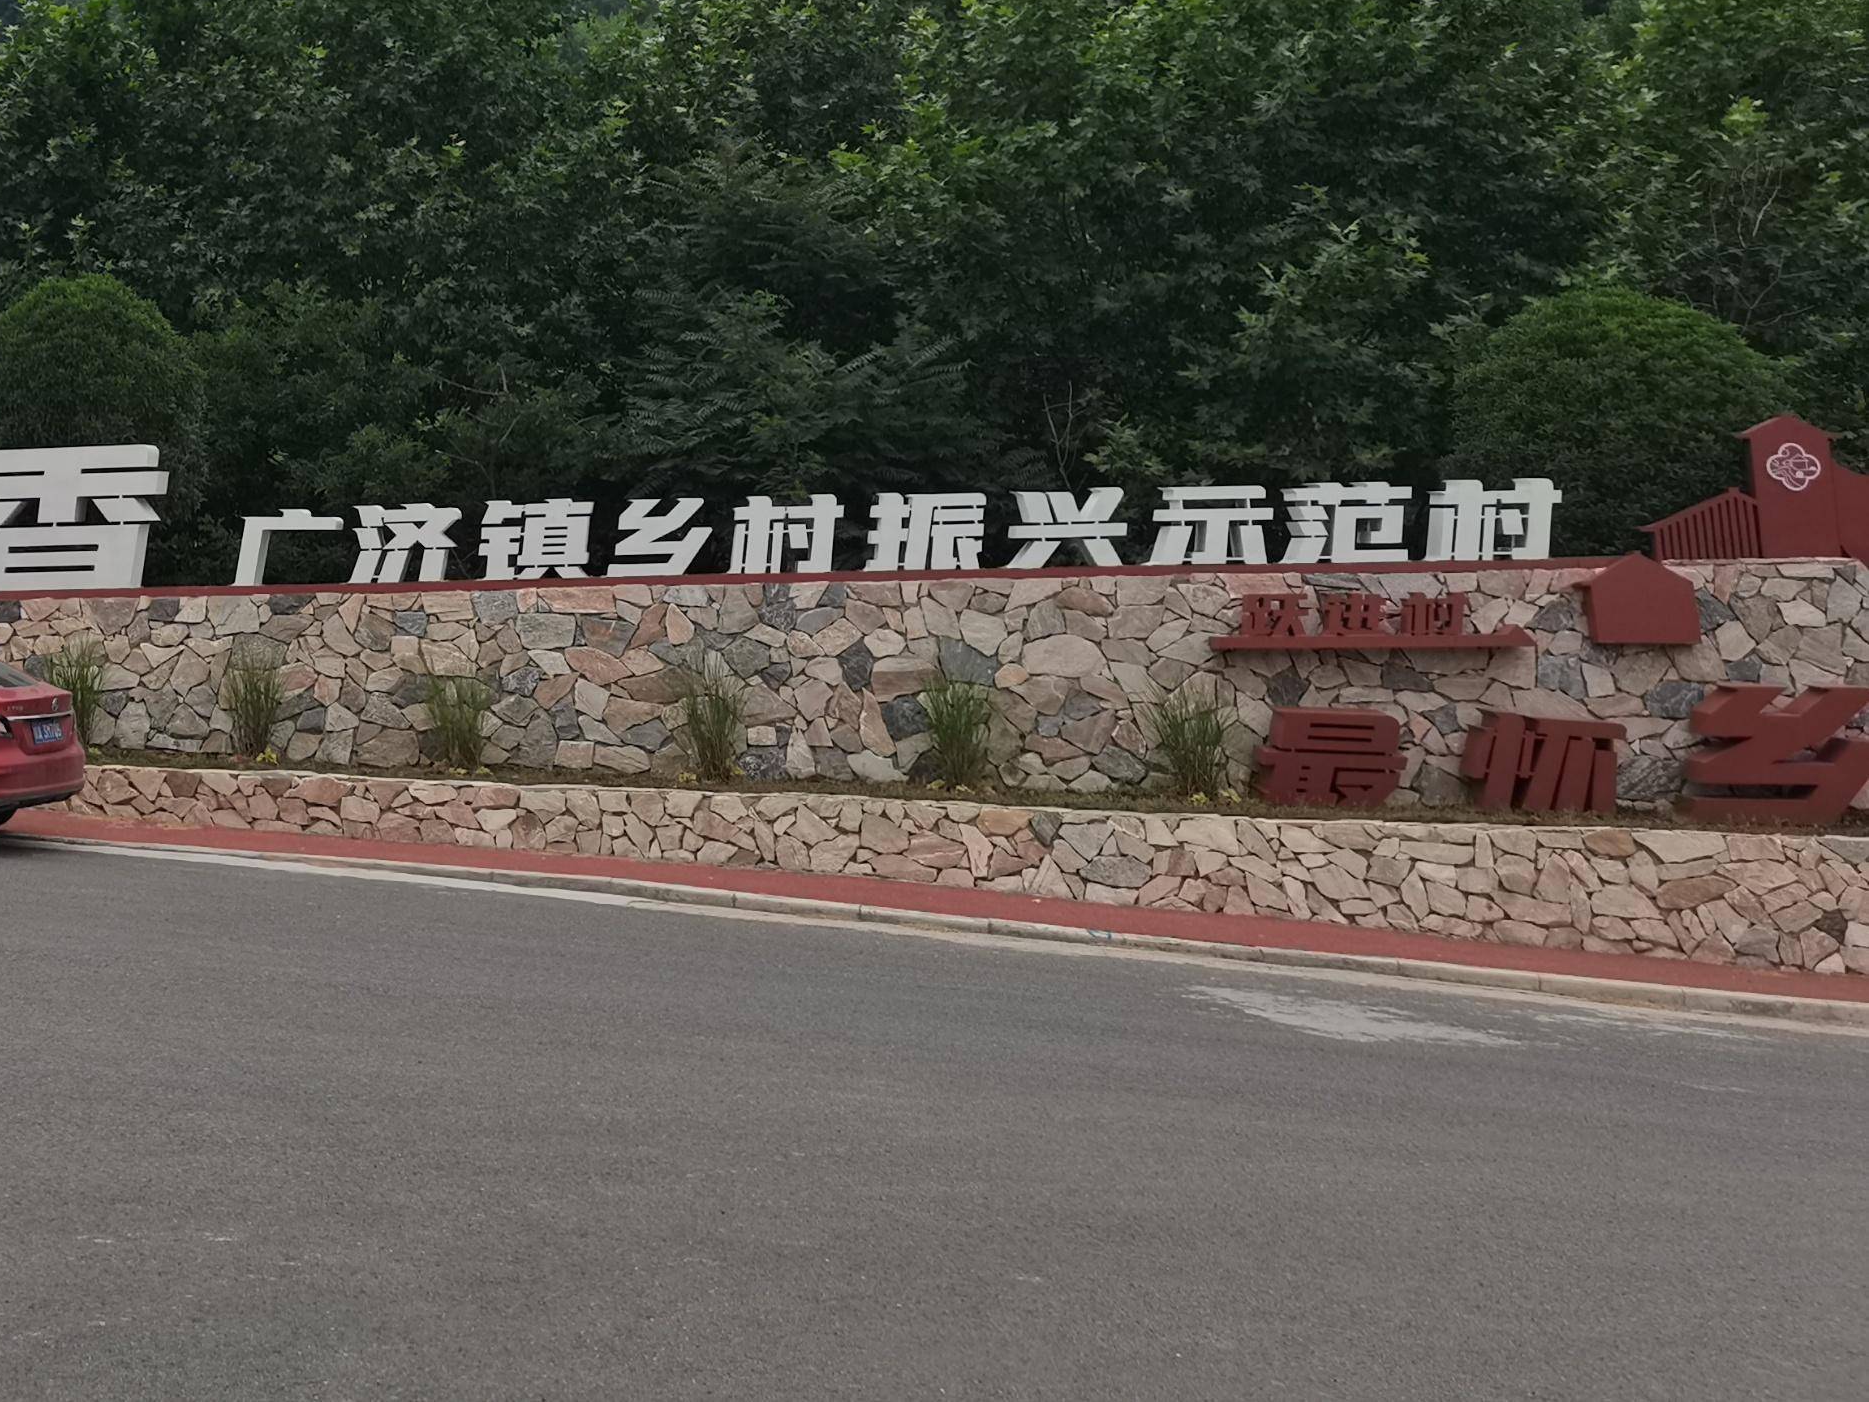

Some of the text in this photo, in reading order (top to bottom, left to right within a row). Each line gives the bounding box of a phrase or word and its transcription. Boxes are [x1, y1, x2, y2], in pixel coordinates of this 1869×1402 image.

[231, 478, 1563, 586] 广济镇乡村振兴示范村
[1238, 592, 1467, 636] 跃进村
[1253, 680, 1869, 825] 最怀乡
